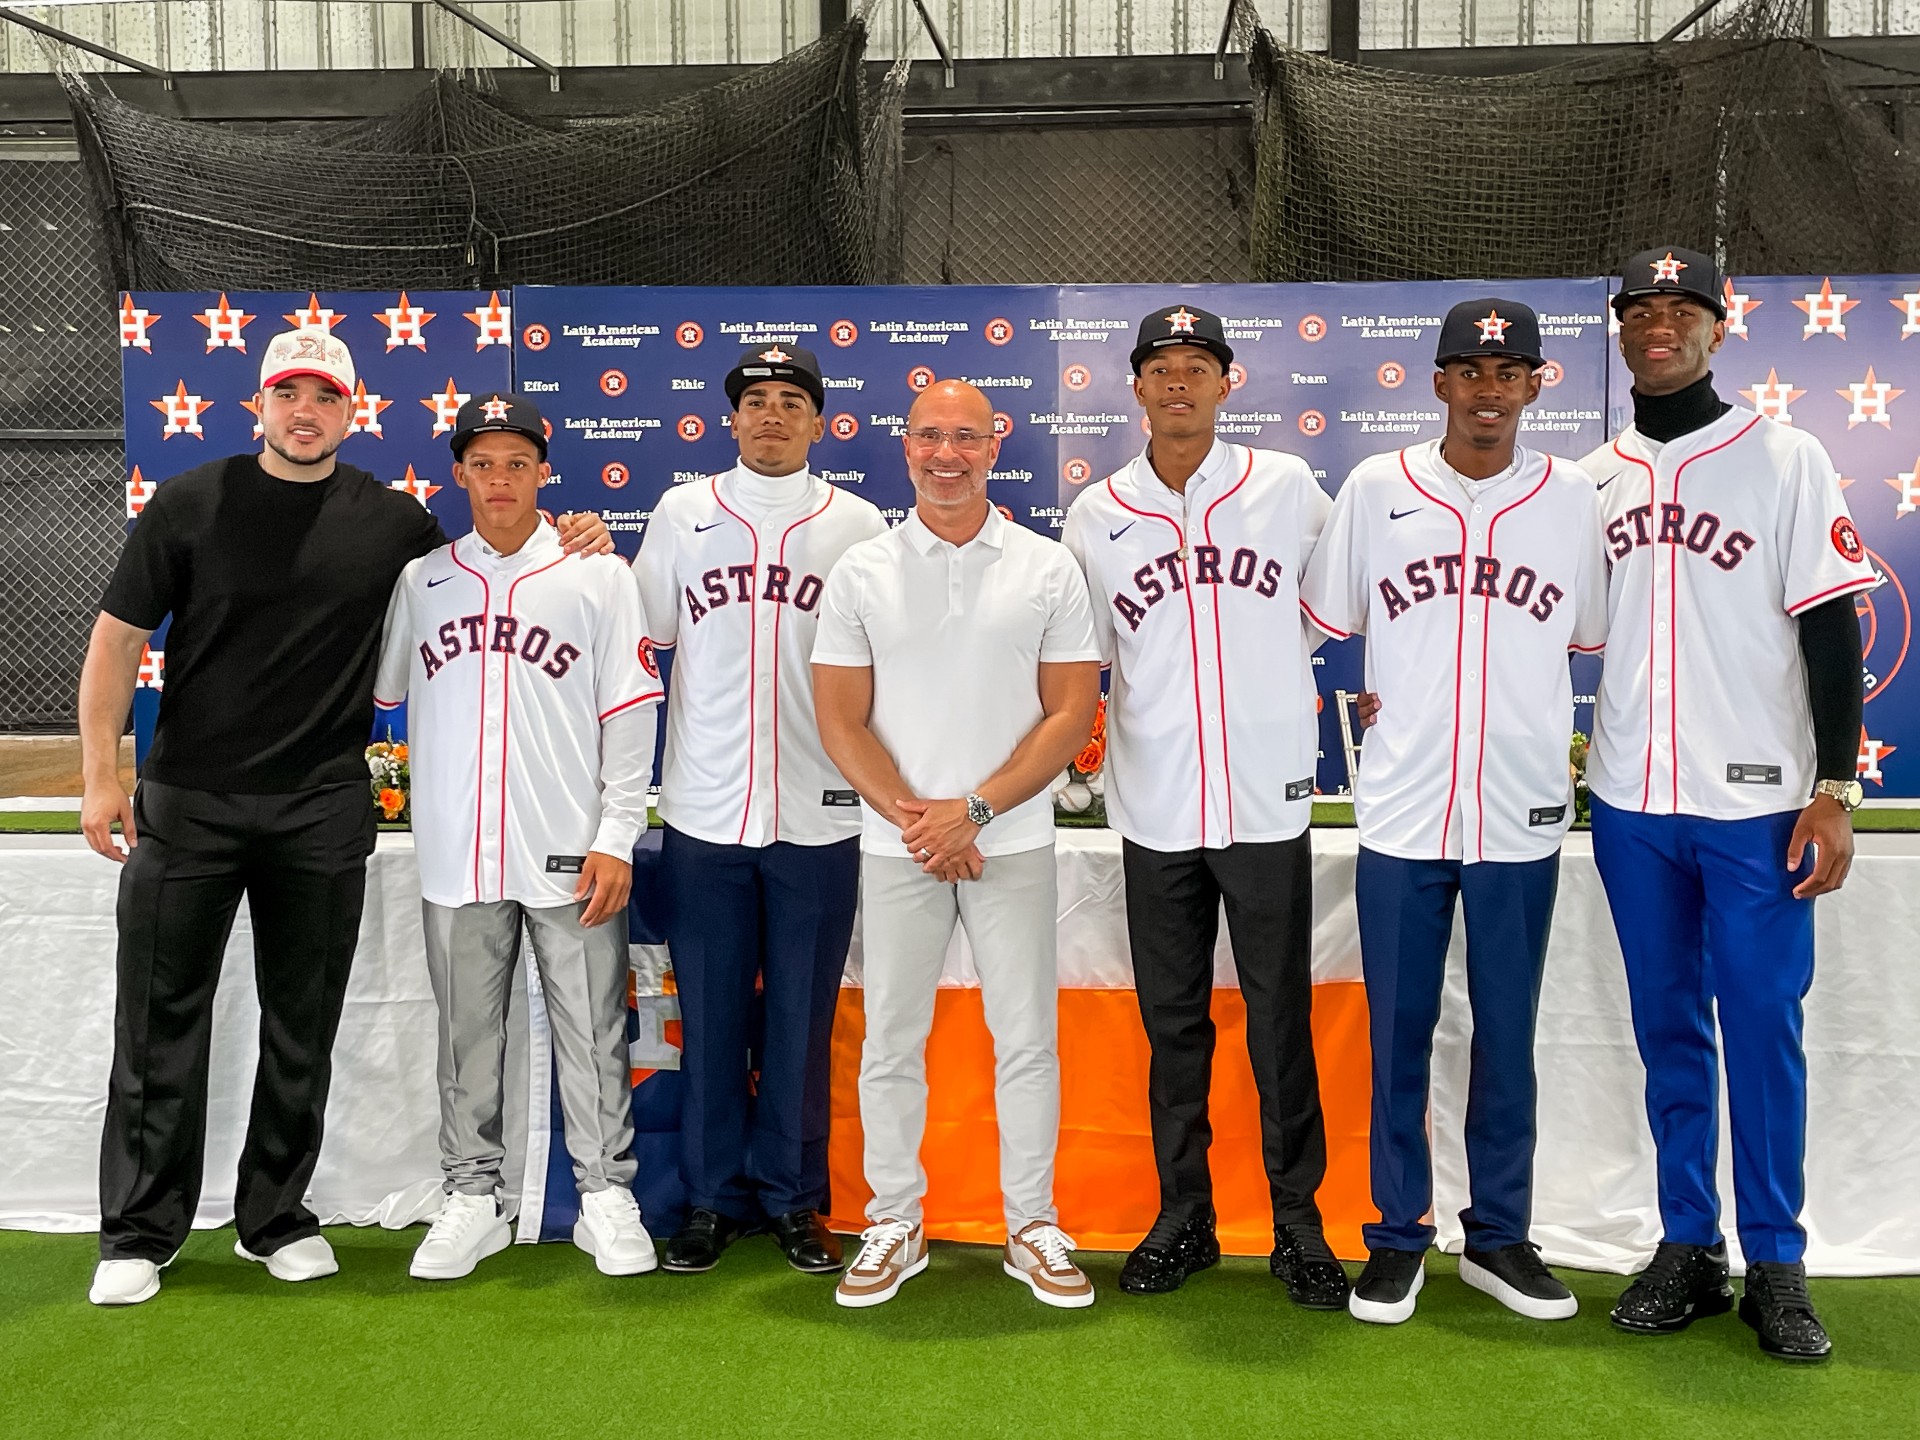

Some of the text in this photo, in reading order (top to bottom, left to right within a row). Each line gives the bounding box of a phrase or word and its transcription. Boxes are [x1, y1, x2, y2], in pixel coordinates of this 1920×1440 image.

[1538, 314, 1602, 324] American
[1804, 294, 1848, 333] H
[385, 306, 427, 346] H
[475, 306, 511, 346] H
[870, 321, 968, 332] Latin American
[1030, 318, 1129, 330] Latin American
[1221, 317, 1282, 328] American
[1341, 315, 1441, 327] Latin American
[205, 308, 246, 347] H
[563, 324, 660, 336] Latin American
[720, 322, 817, 333] Latin American
[1361, 327, 1422, 340] Academy
[1539, 325, 1582, 338] ademy
[739, 334, 798, 345] Academy
[889, 332, 949, 344] Academy
[1049, 330, 1109, 342] Academy
[1223, 329, 1262, 341] demy
[582, 336, 641, 348] Academy
[672, 379, 705, 390] Ethic
[822, 378, 864, 390] Family
[1292, 373, 1327, 385] Team
[524, 381, 560, 392] Effort
[1848, 383, 1891, 422] H
[163, 395, 204, 434] H
[871, 415, 904, 425] Latin
[1030, 412, 1128, 424] Latin American
[1218, 411, 1282, 422] American
[1341, 410, 1441, 422] Latin American
[1537, 409, 1601, 420] American
[565, 417, 661, 429] Latin American
[1360, 422, 1421, 435] Academy
[1520, 421, 1581, 433] Academy
[584, 429, 642, 441] Academy
[1049, 424, 1109, 436] Academy
[1214, 424, 1262, 435] cademy
[673, 472, 706, 482] Ethic
[821, 471, 865, 483] Family
[986, 470, 1033, 482] dership
[602, 510, 653, 520] America
[1030, 507, 1064, 518] Latin
[606, 521, 644, 533] demy
[1605, 502, 1756, 571] STROS
[1113, 545, 1282, 632] ASTROS
[1378, 553, 1564, 622] ASTROS
[685, 564, 825, 625] ASTRO
[419, 613, 581, 681] ASTROS
